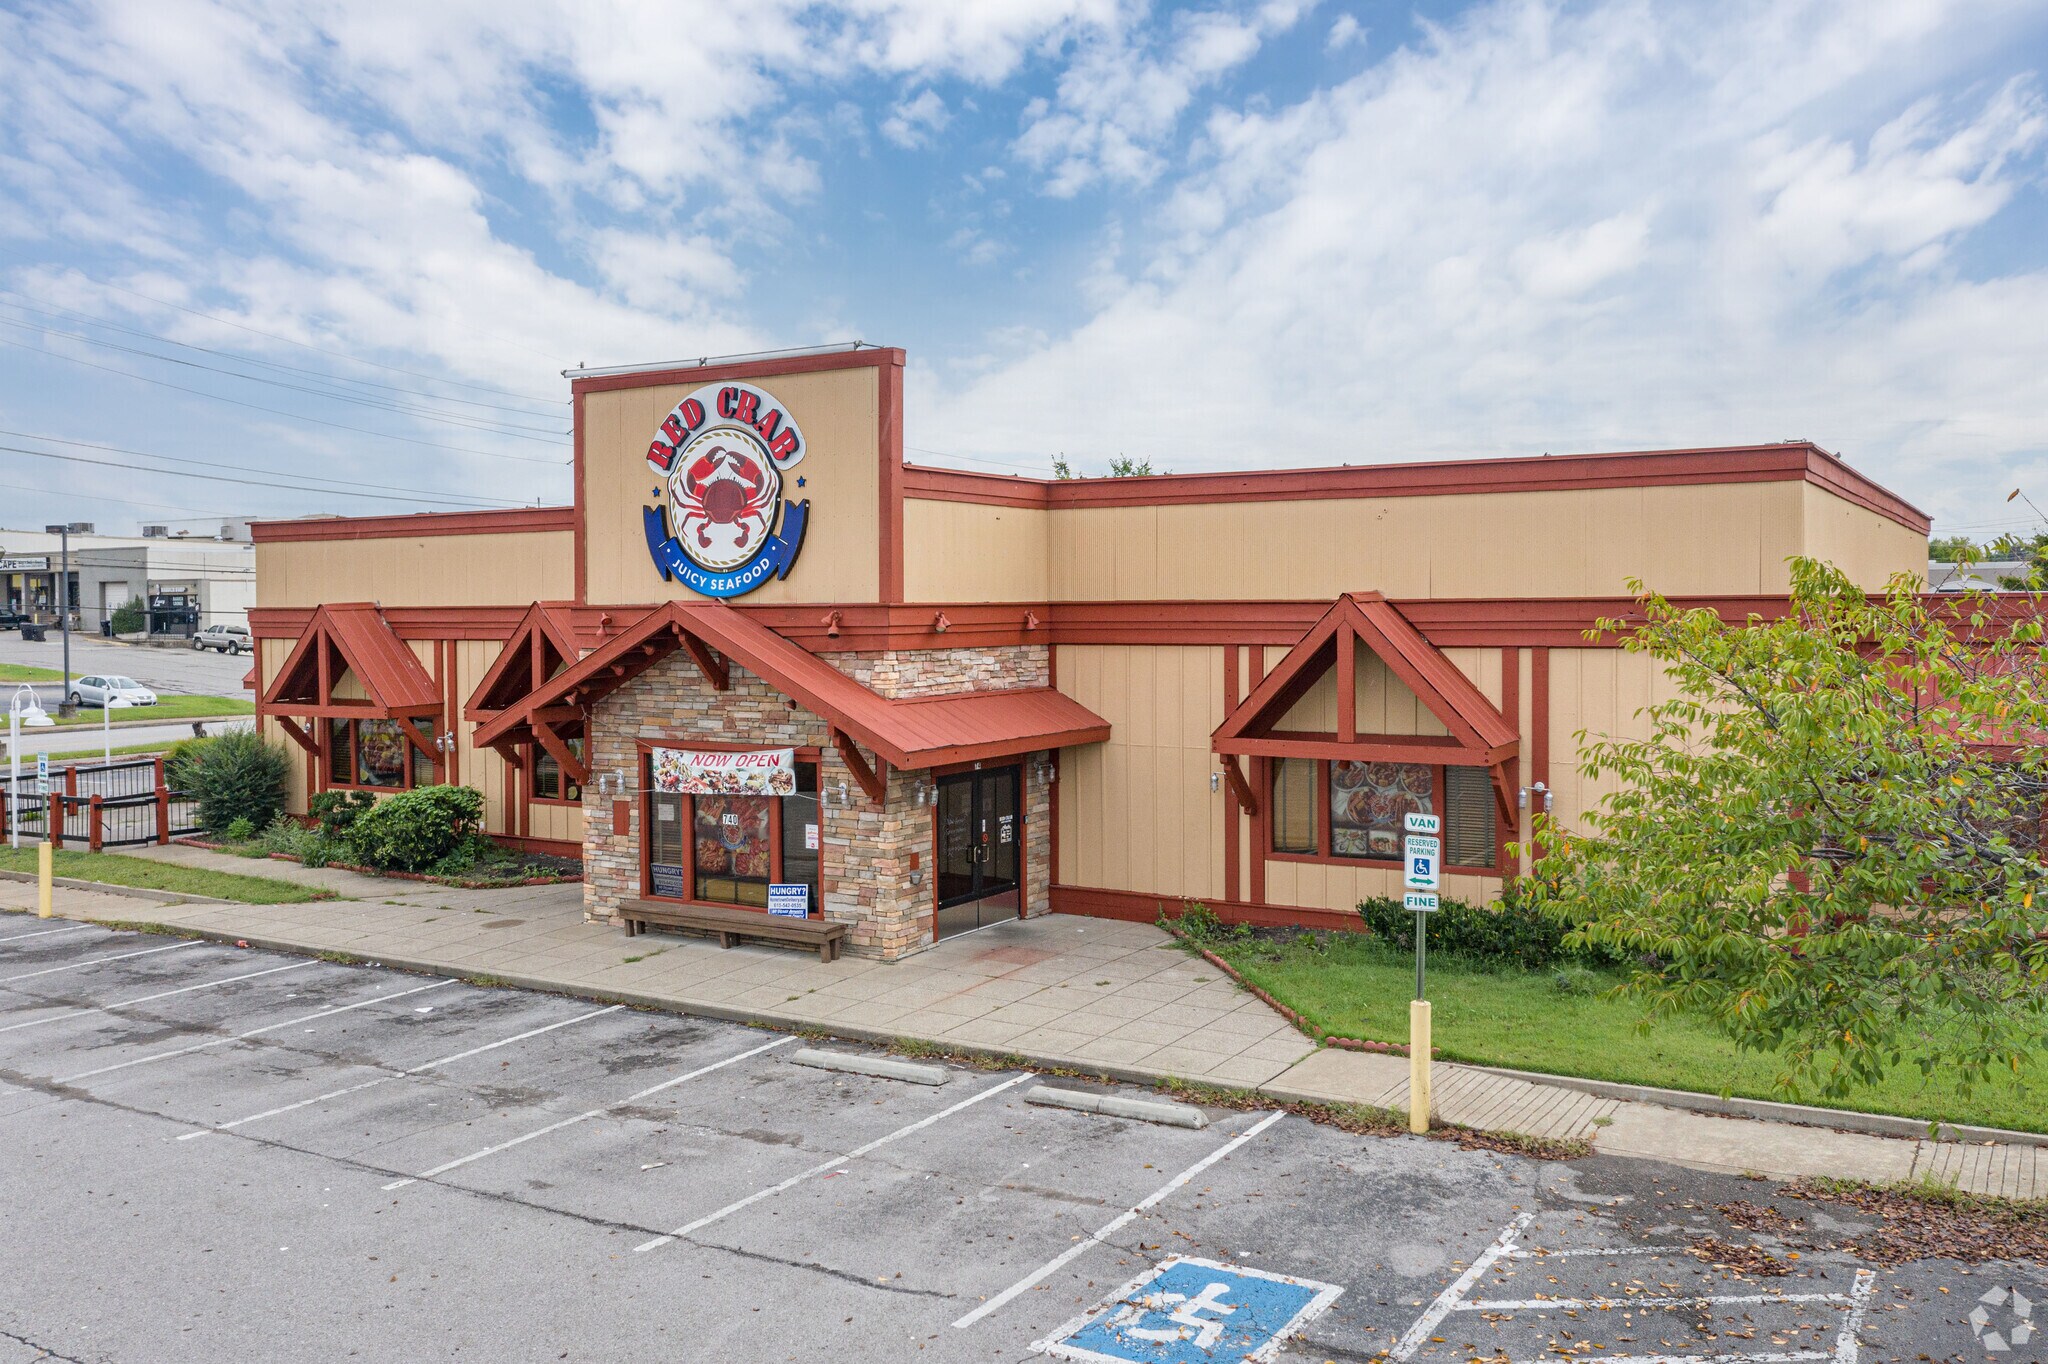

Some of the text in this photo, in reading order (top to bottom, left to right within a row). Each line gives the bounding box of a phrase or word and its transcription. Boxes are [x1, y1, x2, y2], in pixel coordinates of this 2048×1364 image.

[646, 387, 799, 470] RED CRAB
[672, 558, 770, 590] JUICY SEAFOOD
[690, 754, 781, 767] NOW OPEN
[724, 814, 737, 825] 740
[1409, 817, 1436, 829] VAN
[1407, 838, 1437, 848] RESERVED
[1409, 847, 1435, 856] PARKING
[770, 887, 806, 895] HUNGRY?
[1406, 896, 1436, 907] FINE
